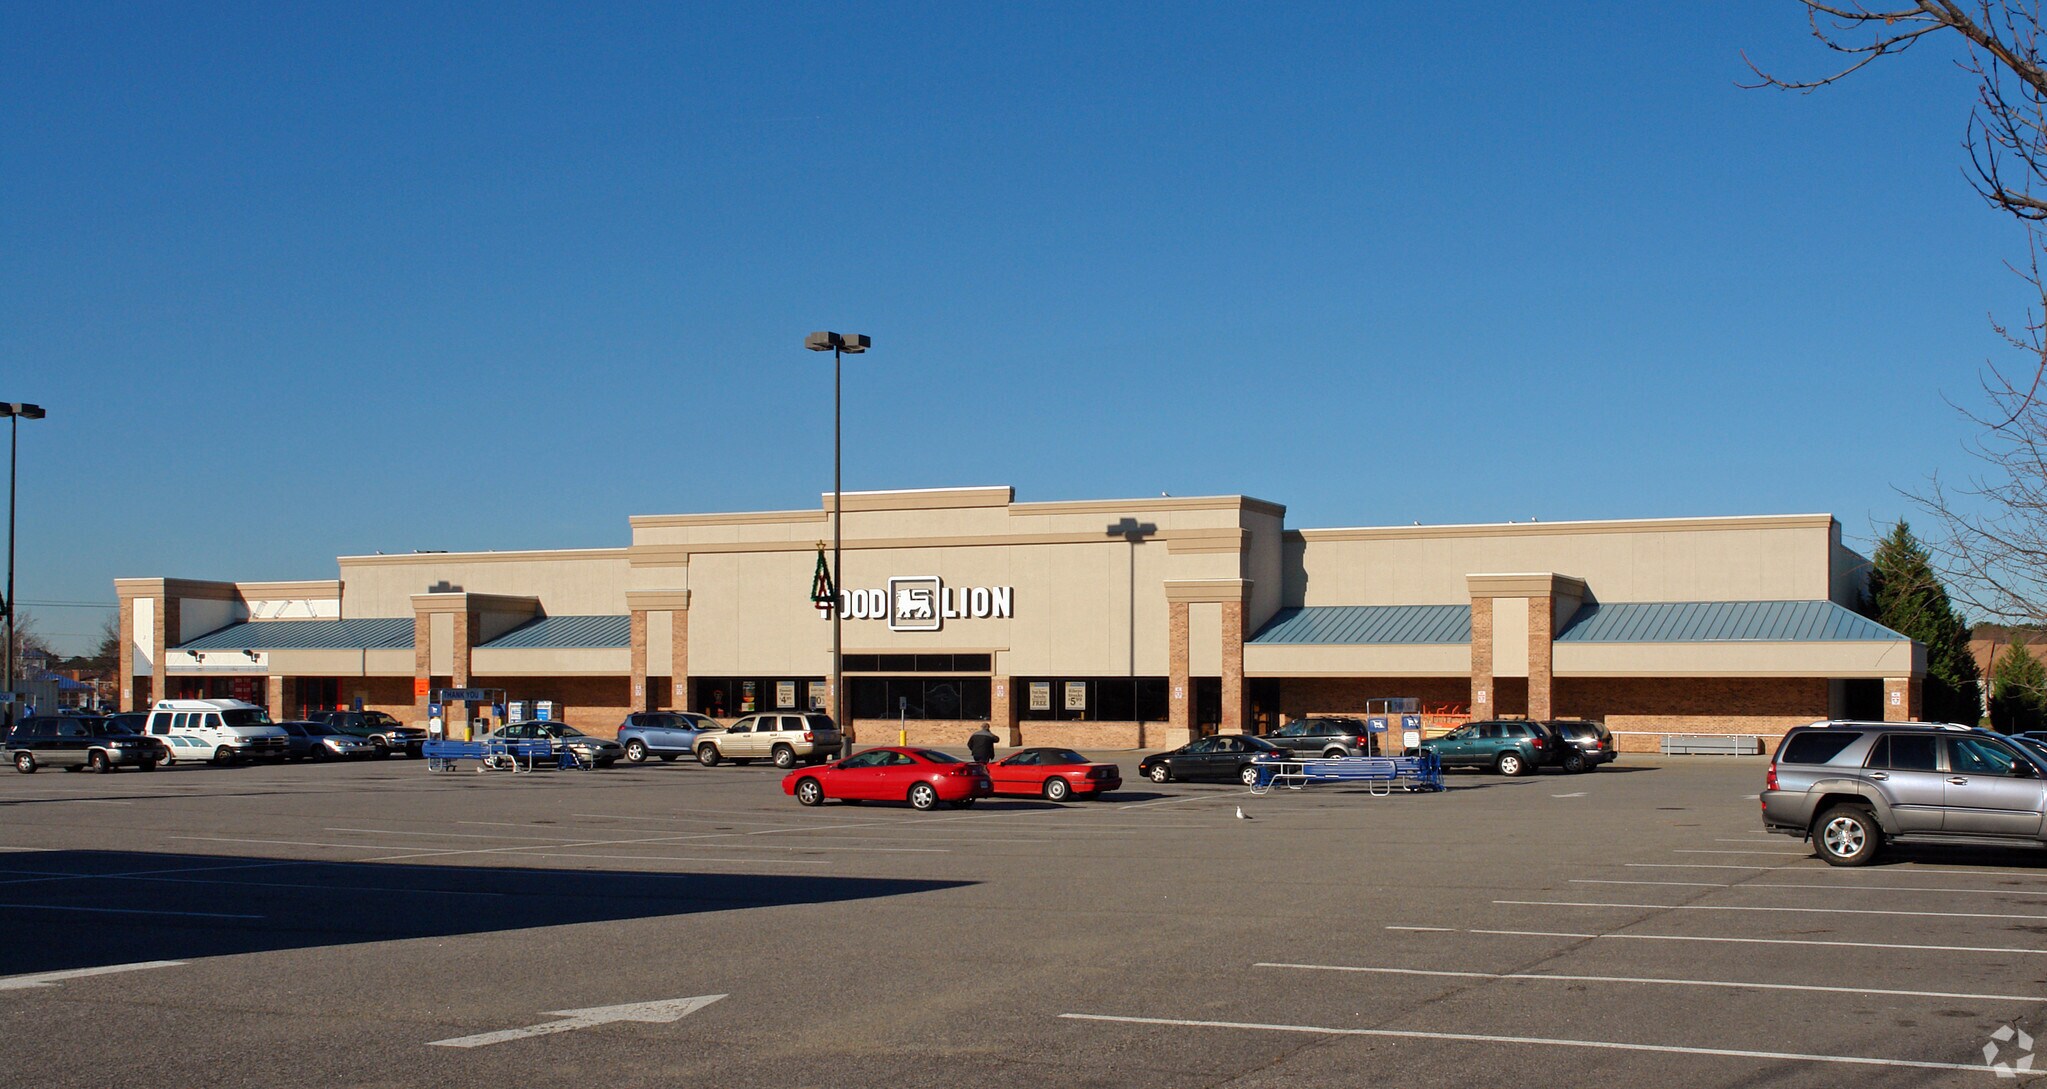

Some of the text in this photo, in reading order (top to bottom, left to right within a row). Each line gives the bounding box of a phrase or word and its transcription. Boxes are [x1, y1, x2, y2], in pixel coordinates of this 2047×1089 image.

[942, 587, 1013, 619] LION
[444, 690, 479, 699] THANK YOU
